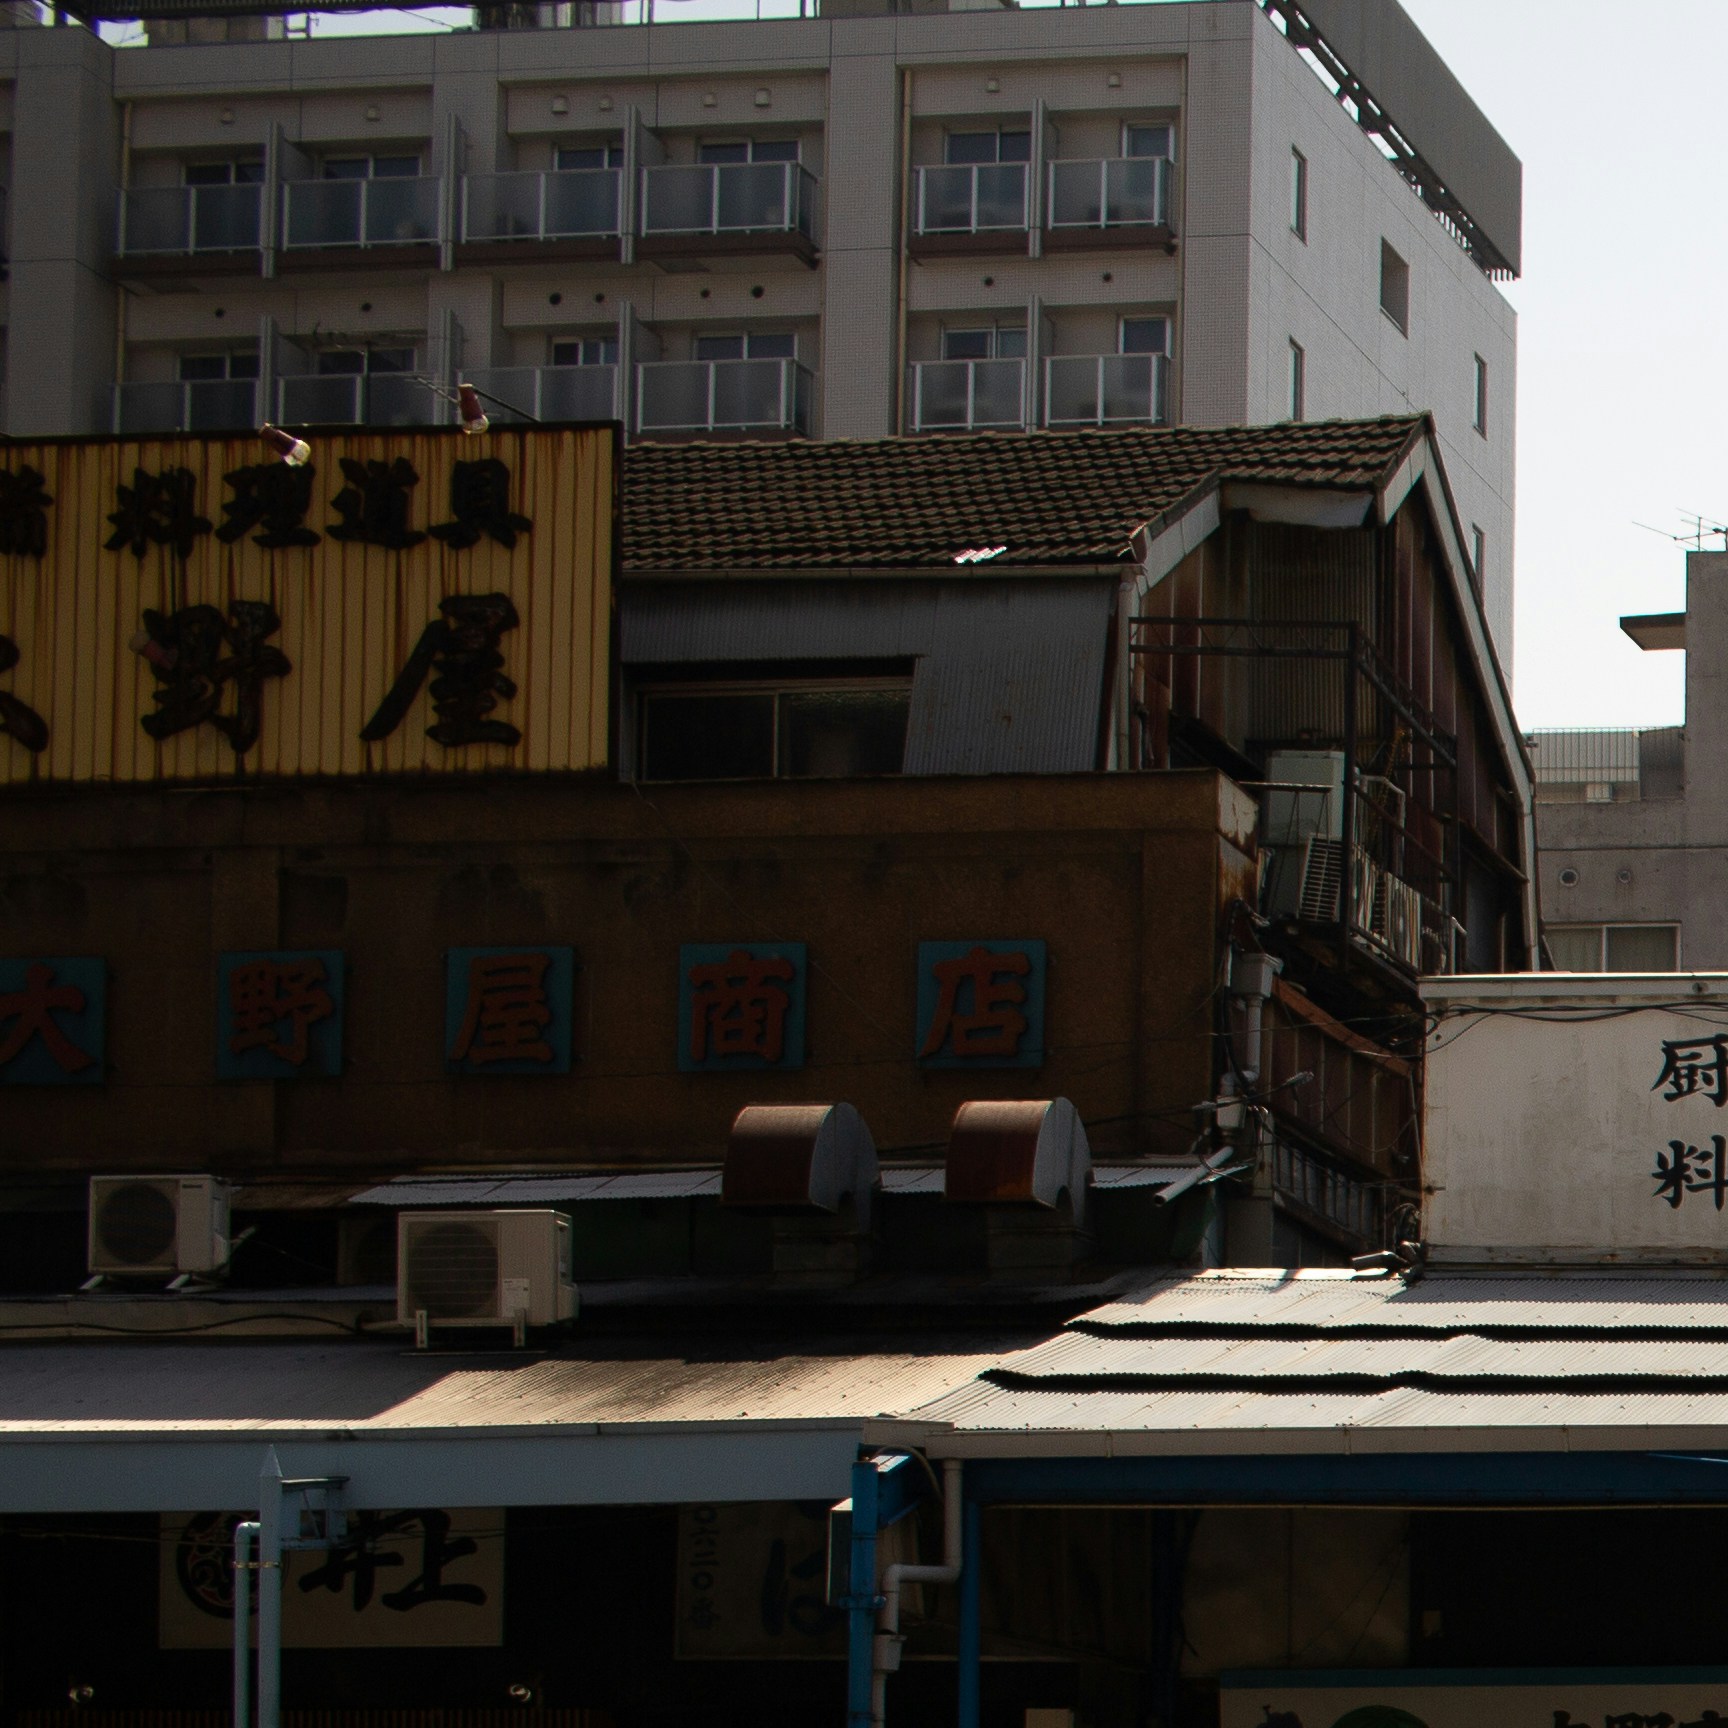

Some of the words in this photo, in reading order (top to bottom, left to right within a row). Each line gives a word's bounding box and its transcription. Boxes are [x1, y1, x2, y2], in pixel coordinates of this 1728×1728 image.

[0, 946, 1033, 1076] 大野屋商店
